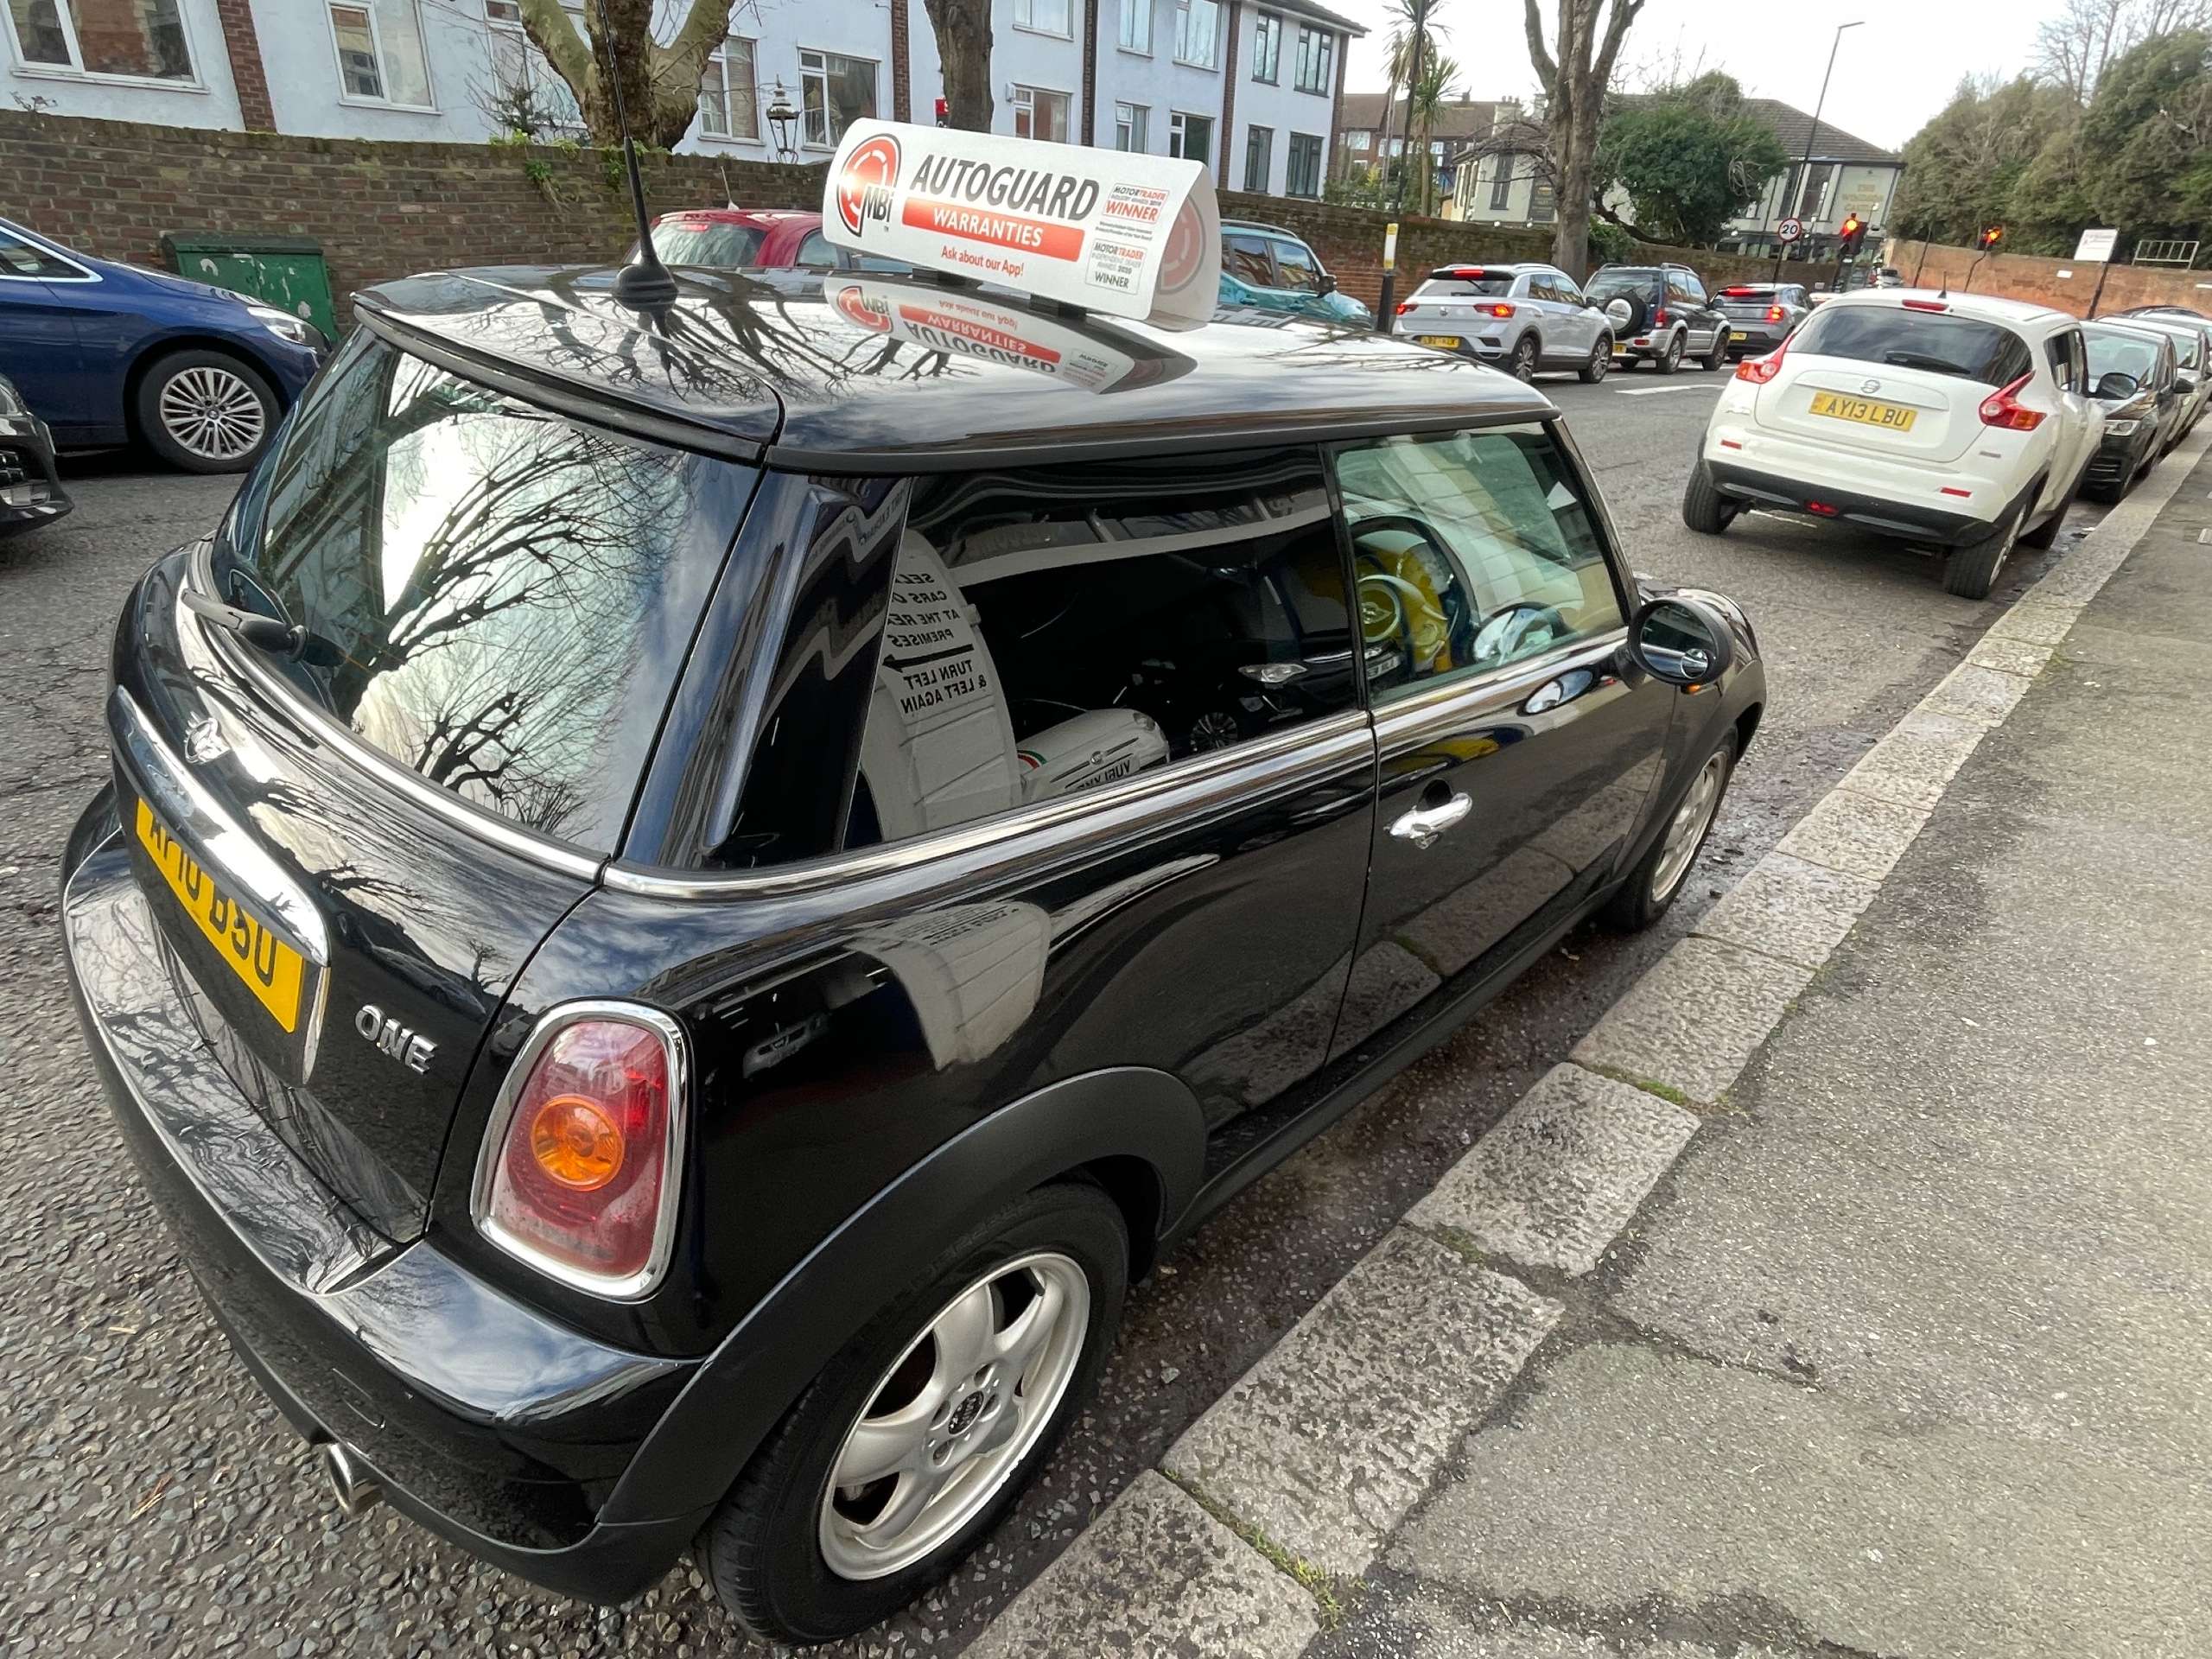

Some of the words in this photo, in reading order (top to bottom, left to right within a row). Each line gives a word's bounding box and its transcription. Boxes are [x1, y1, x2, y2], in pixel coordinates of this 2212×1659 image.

[909, 154, 1100, 221] AUTOGUARD
[1105, 200, 1159, 222] WINNER
[933, 207, 1044, 248] WARRANTIES
[1782, 224, 1798, 235] 20
[941, 245, 957, 258] Ask
[958, 249, 983, 268] about
[985, 257, 1001, 270] our
[1001, 259, 1025, 278] App!
[1095, 270, 1130, 289] WINNER
[1826, 398, 1868, 419] AY13
[1869, 406, 1910, 427] LBU
[354, 1005, 438, 1076] ONE
